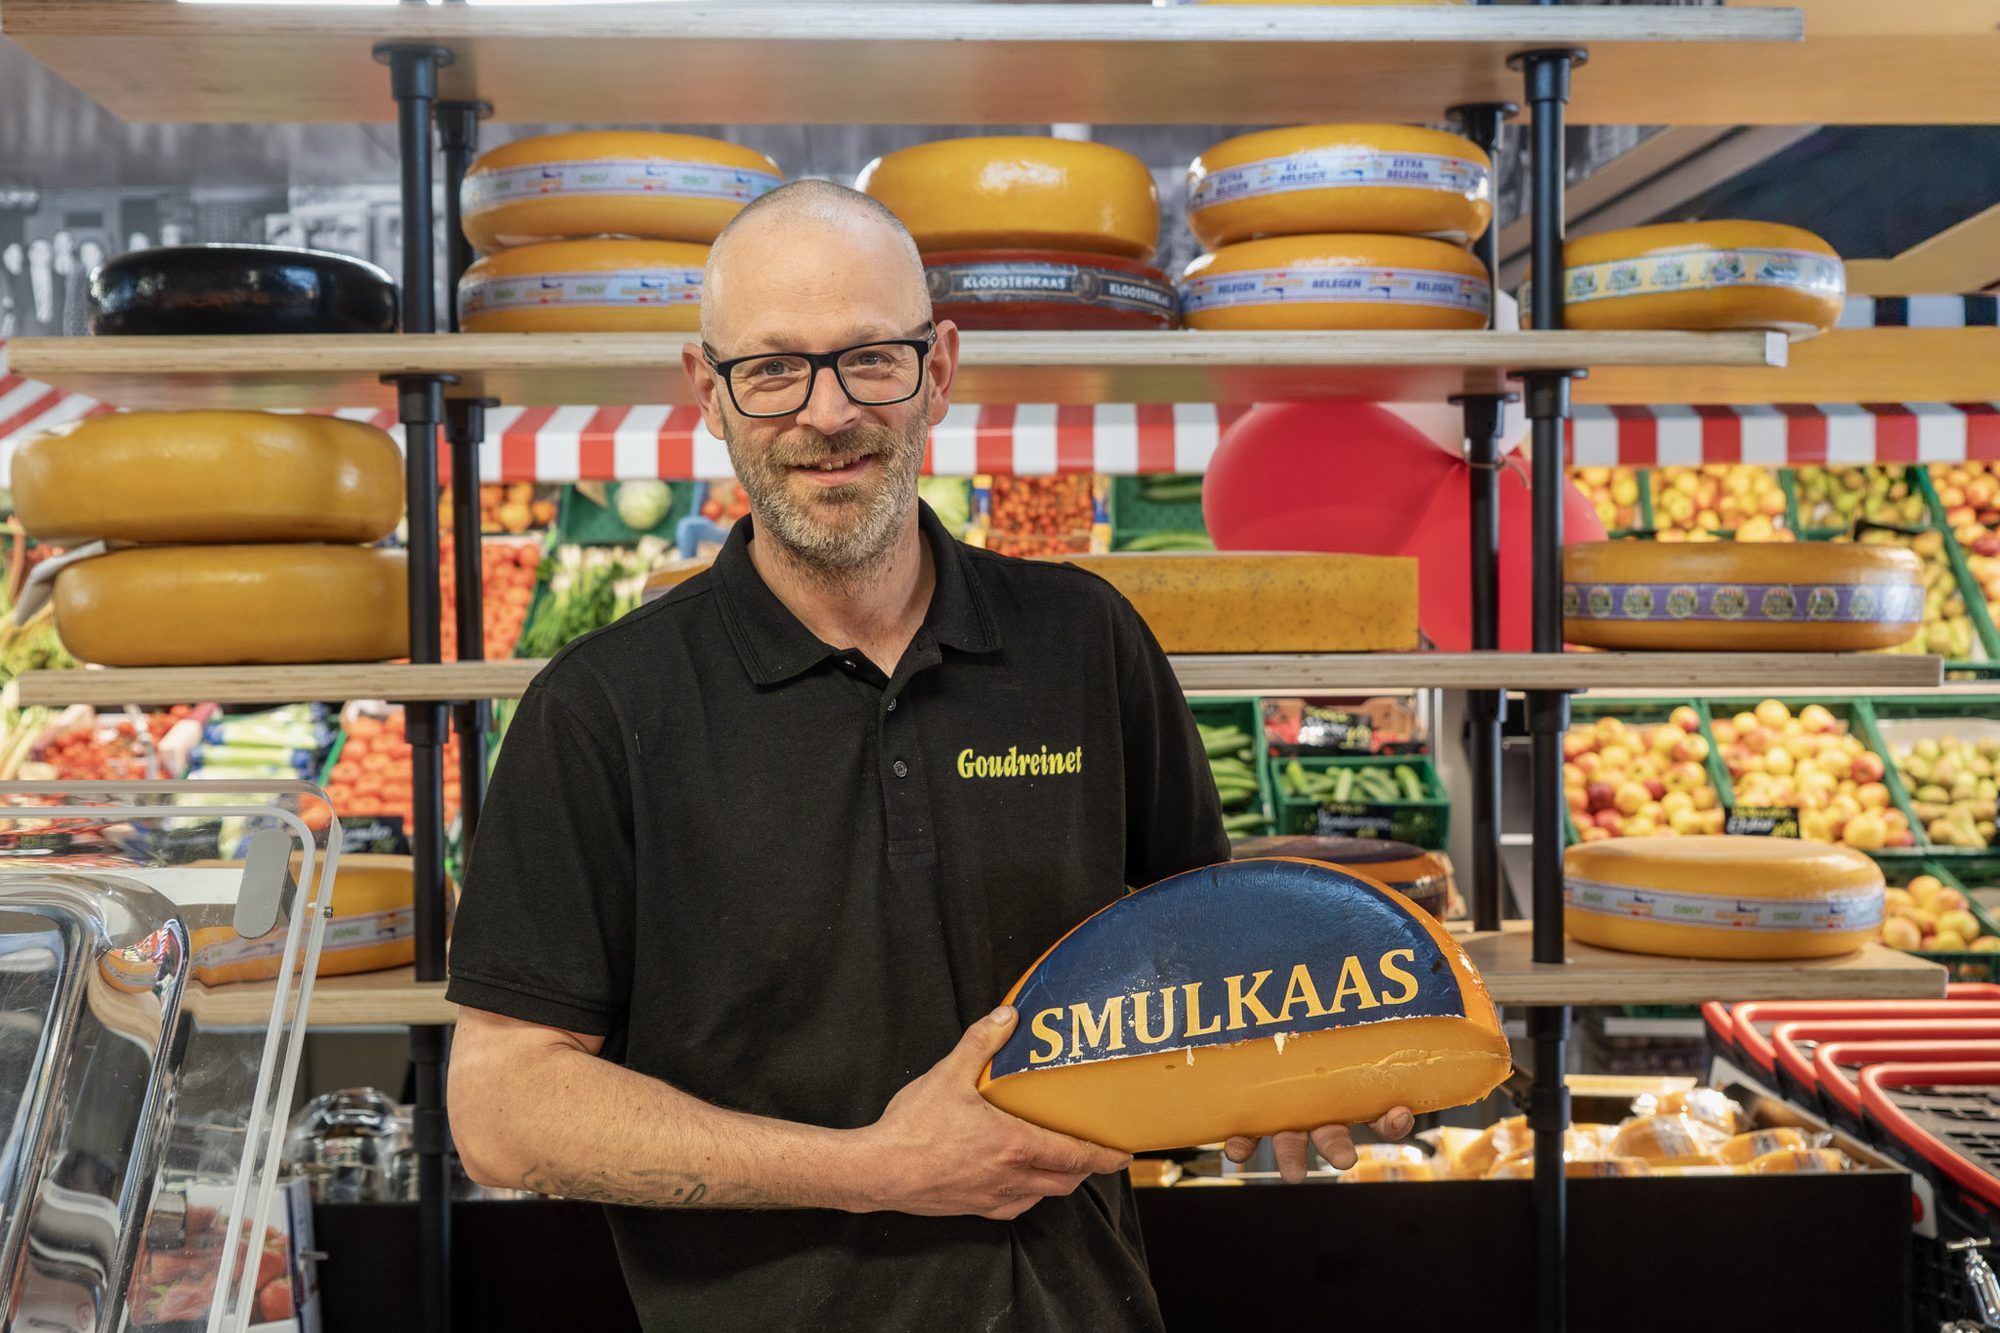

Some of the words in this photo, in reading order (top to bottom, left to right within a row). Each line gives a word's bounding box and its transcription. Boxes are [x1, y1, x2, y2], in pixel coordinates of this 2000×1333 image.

[1392, 157, 1424, 168] EXTRA
[1386, 168, 1429, 179] BELEGEN
[962, 275, 1067, 290] KLOOSTERKAAS
[1217, 281, 1256, 294] BELEGEN
[1311, 279, 1363, 289] BELEGEN
[1415, 280, 1454, 292] BELEGEN
[957, 744, 1082, 778] Goudreinet
[1029, 948, 1419, 1065] SMULKAAS
